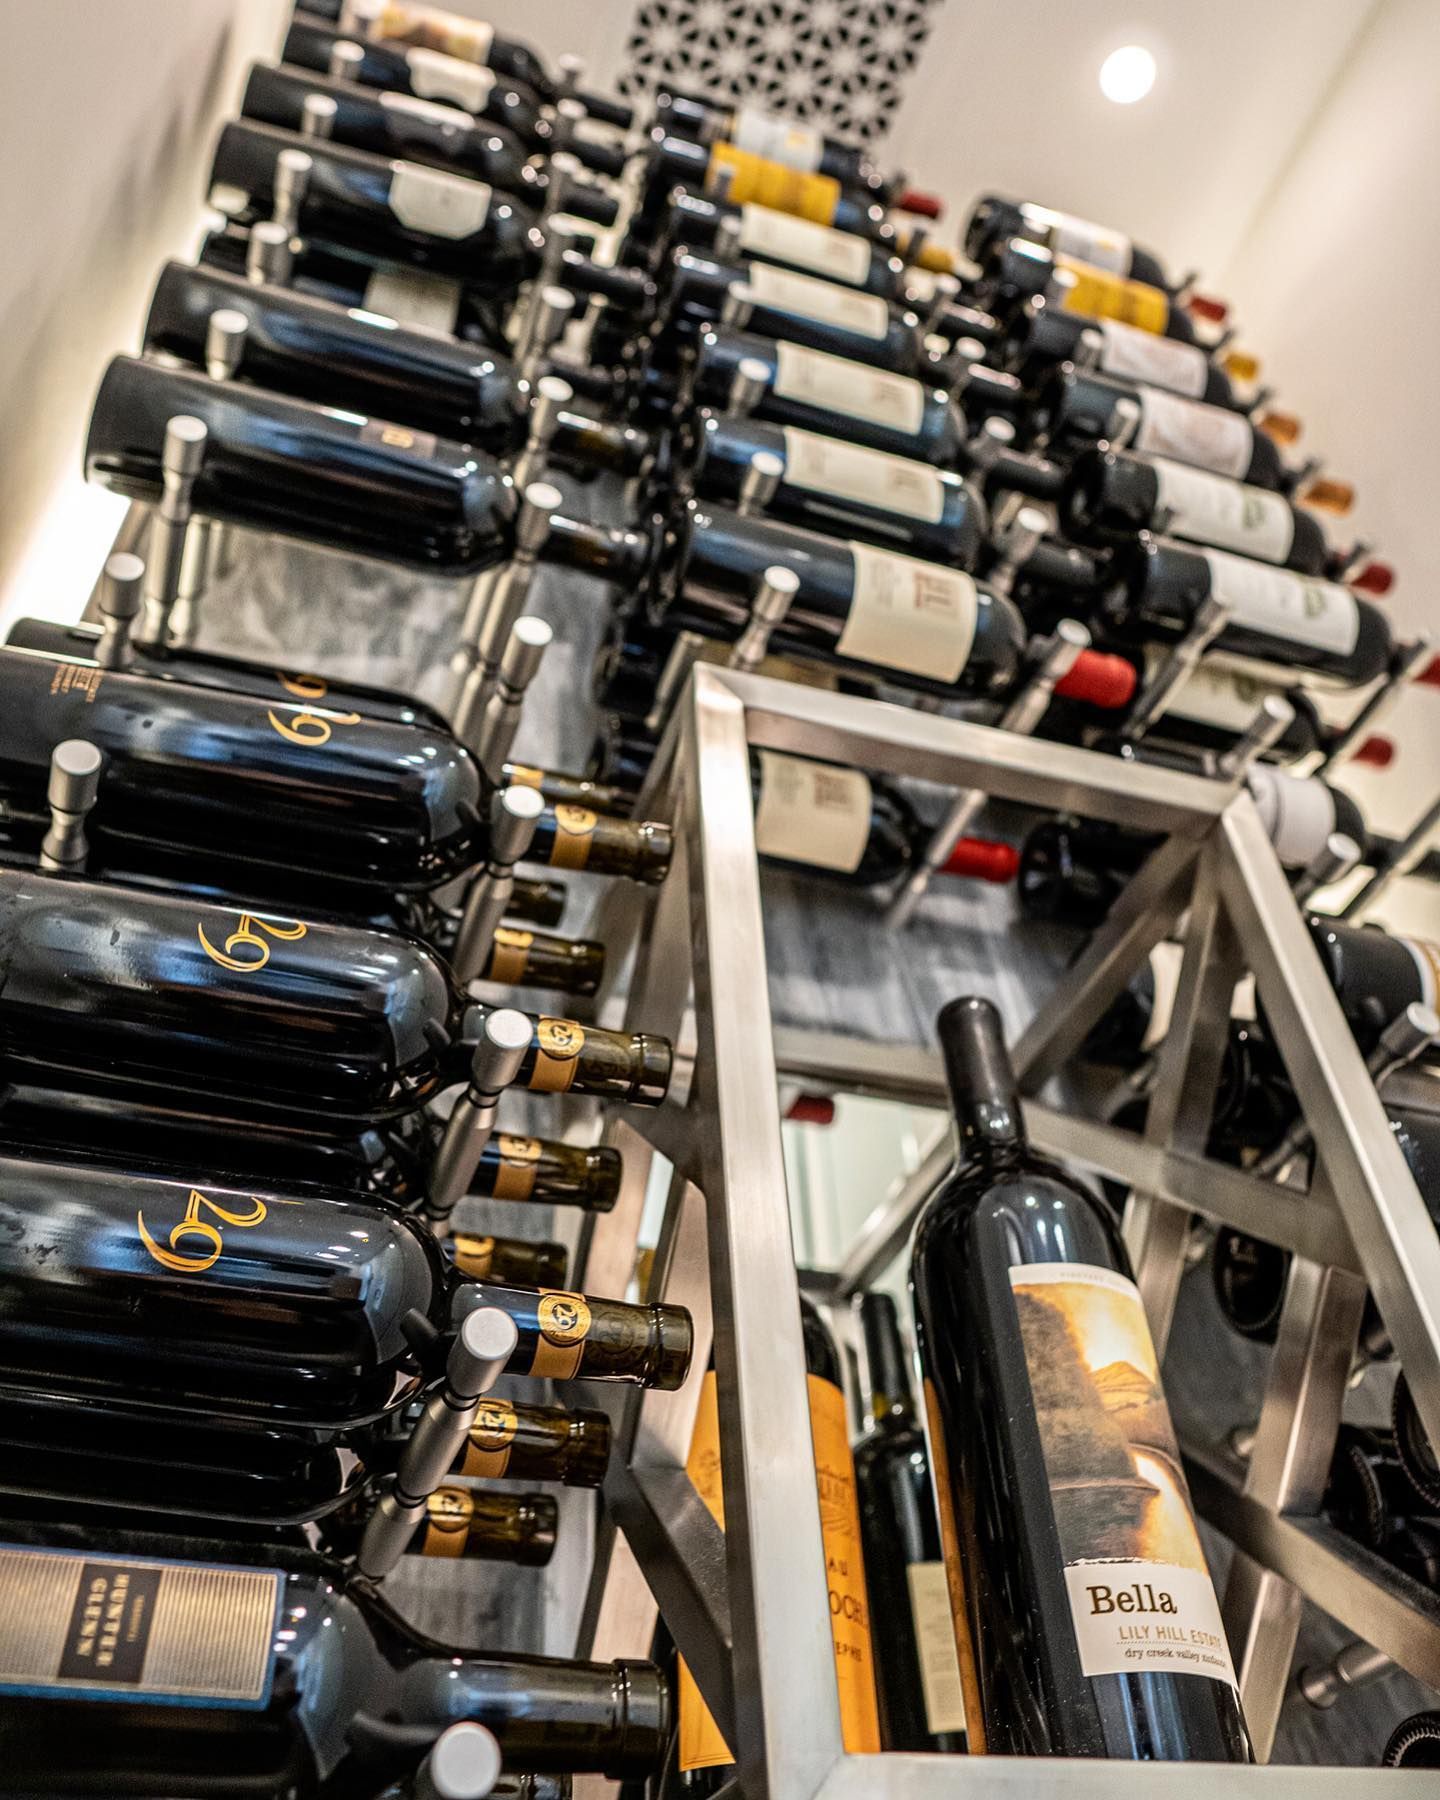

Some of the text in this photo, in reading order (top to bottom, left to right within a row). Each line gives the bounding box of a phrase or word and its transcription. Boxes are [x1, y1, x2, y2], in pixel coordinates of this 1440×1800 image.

[138, 1189, 268, 1273] 29
[552, 1303, 579, 1331] 29
[1086, 1584, 1178, 1615] Bella
[95, 1573, 130, 1668] HUNTER
[1119, 1625, 1150, 1640] LILY
[1156, 1625, 1187, 1642] HILL
[1125, 1648, 1144, 1660] dry
[1146, 1647, 1175, 1659] creek
